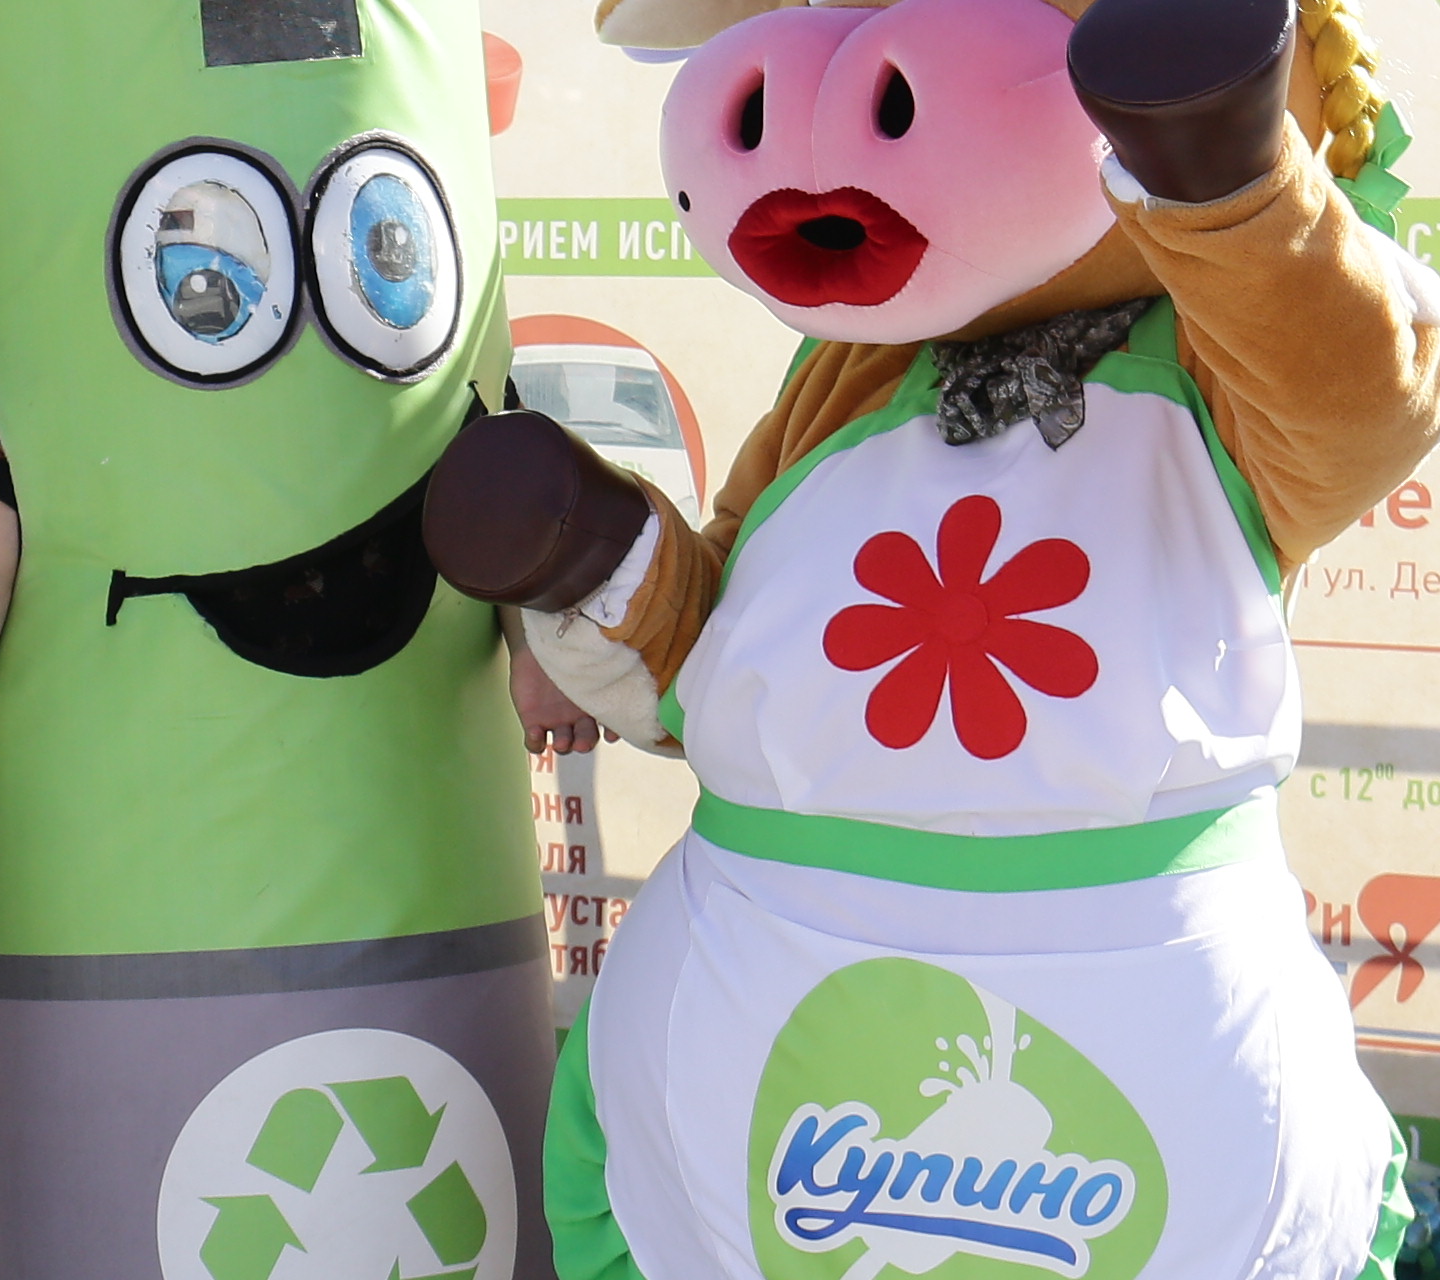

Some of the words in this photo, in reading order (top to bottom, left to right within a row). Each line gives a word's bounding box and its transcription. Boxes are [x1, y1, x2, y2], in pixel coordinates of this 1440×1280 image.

[498, 220, 598, 260] РИЕМ
[619, 221, 693, 260] ИСП
[1324, 566, 1377, 598] ул.
[776, 1113, 1124, 1267] Купино
